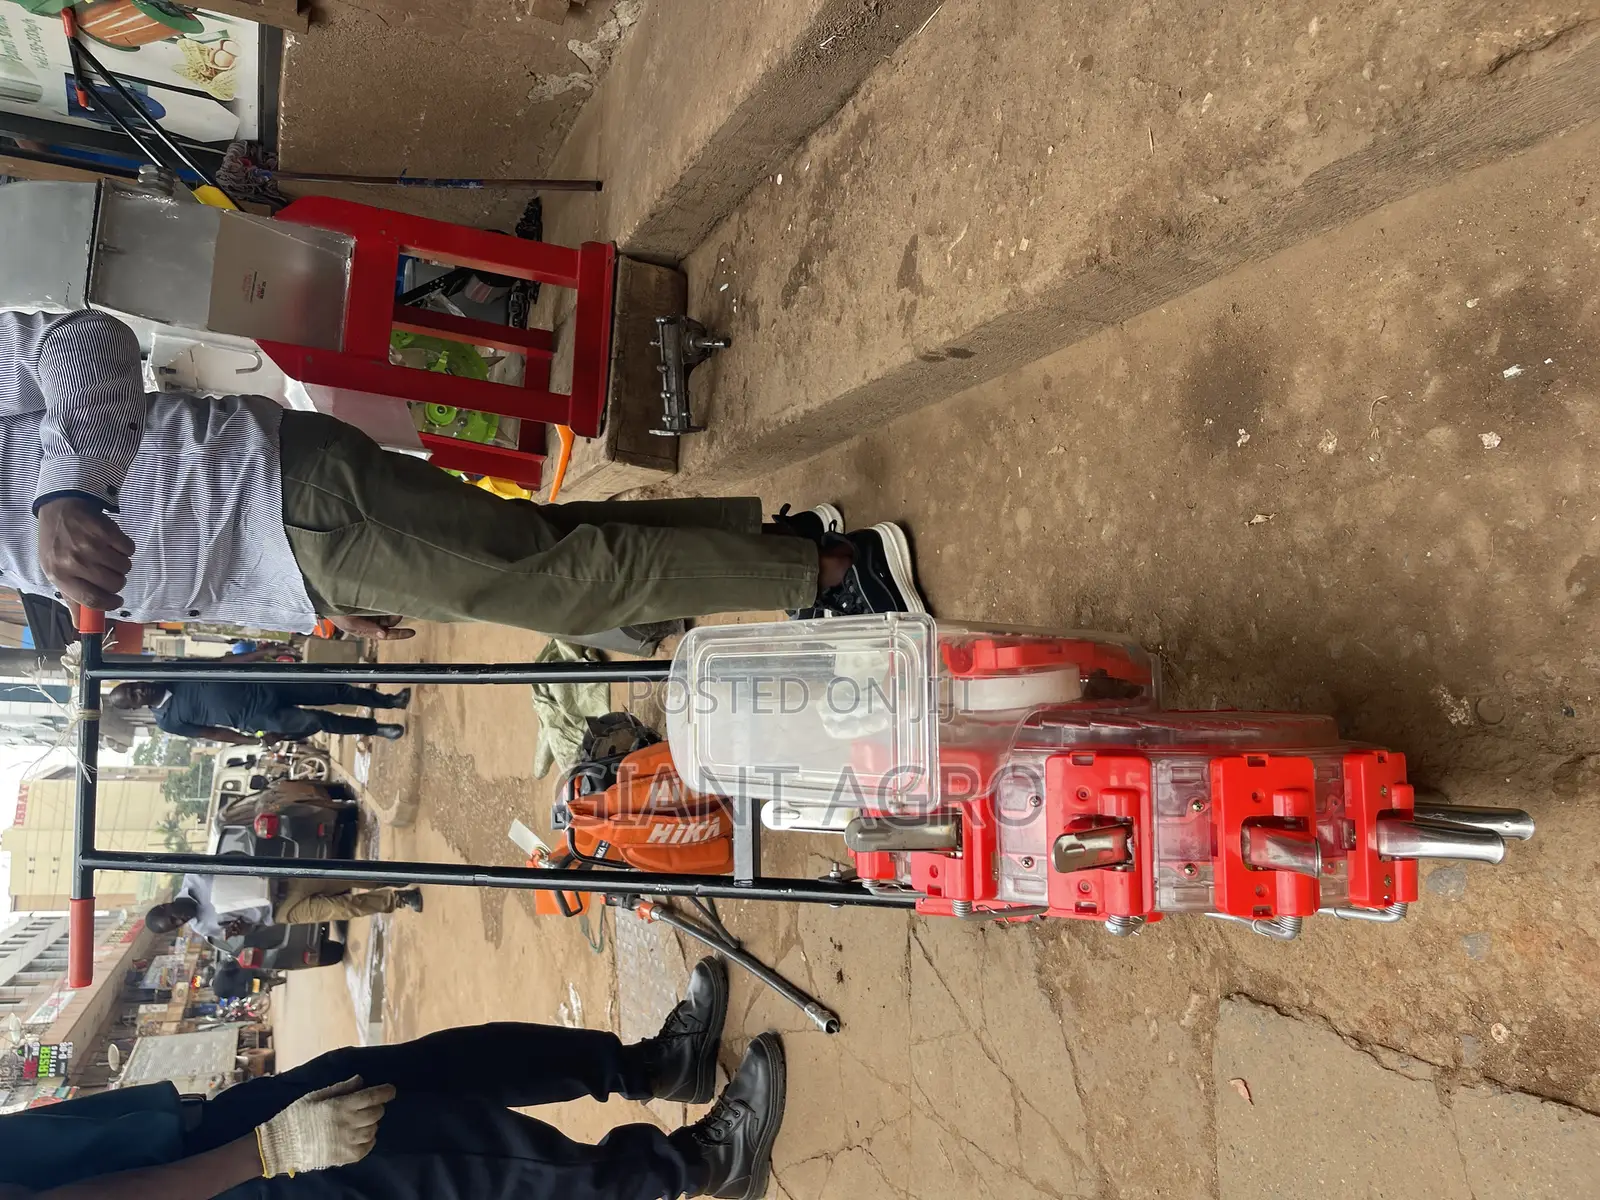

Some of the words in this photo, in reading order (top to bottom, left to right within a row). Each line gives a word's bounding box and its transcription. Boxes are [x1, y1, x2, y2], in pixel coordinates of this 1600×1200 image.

[14, 784, 30, 826] ISBAT
[38, 1046, 51, 1078] LASER
[48, 1046, 58, 1078] CUTTING
